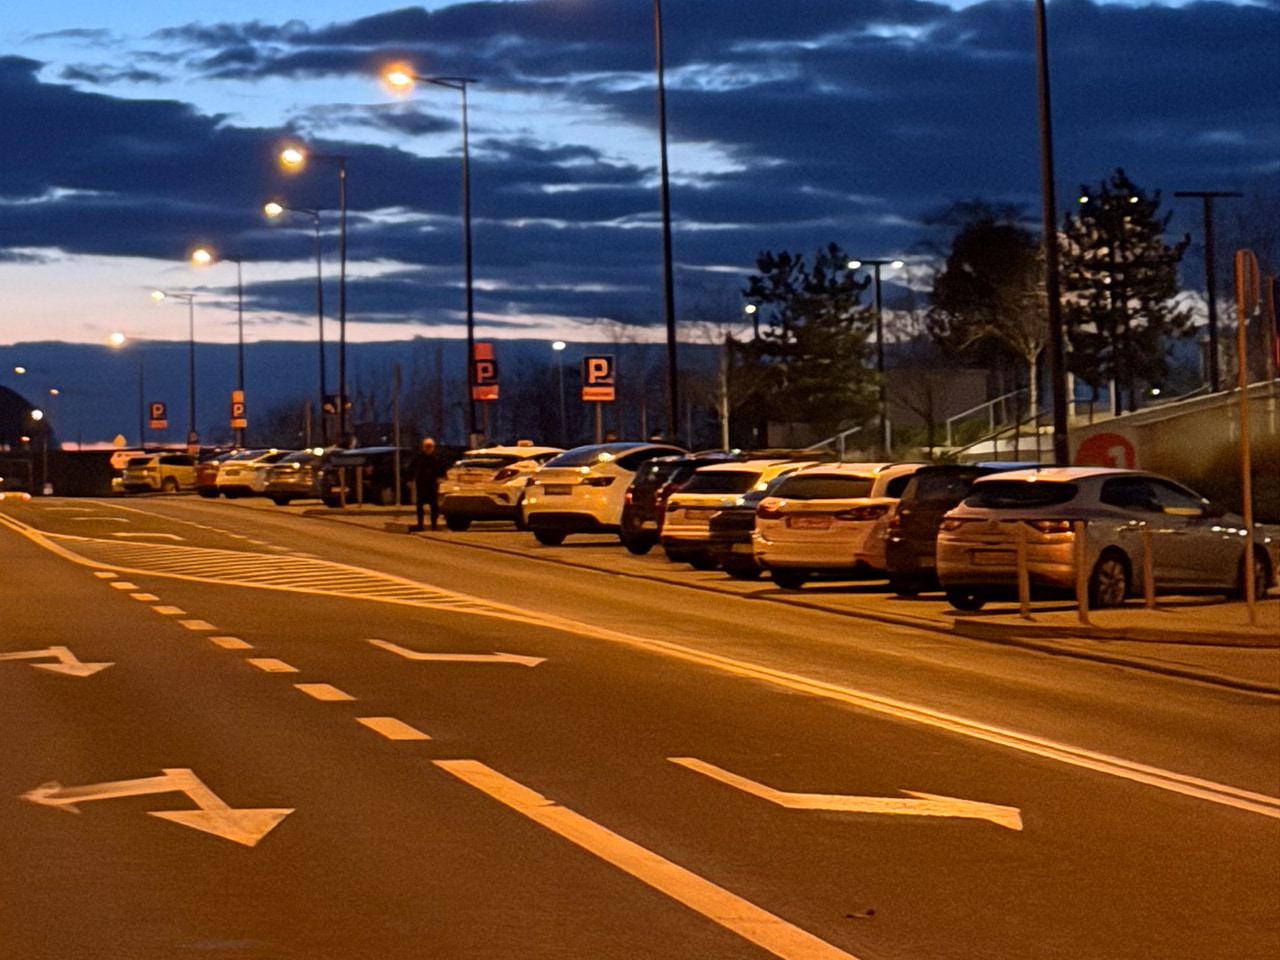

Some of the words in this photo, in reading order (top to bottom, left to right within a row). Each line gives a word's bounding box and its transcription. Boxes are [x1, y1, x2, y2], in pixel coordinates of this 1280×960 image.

[477, 362, 494, 384] P
[588, 358, 608, 384] P
[152, 403, 164, 418] P
[233, 403, 244, 418] P
